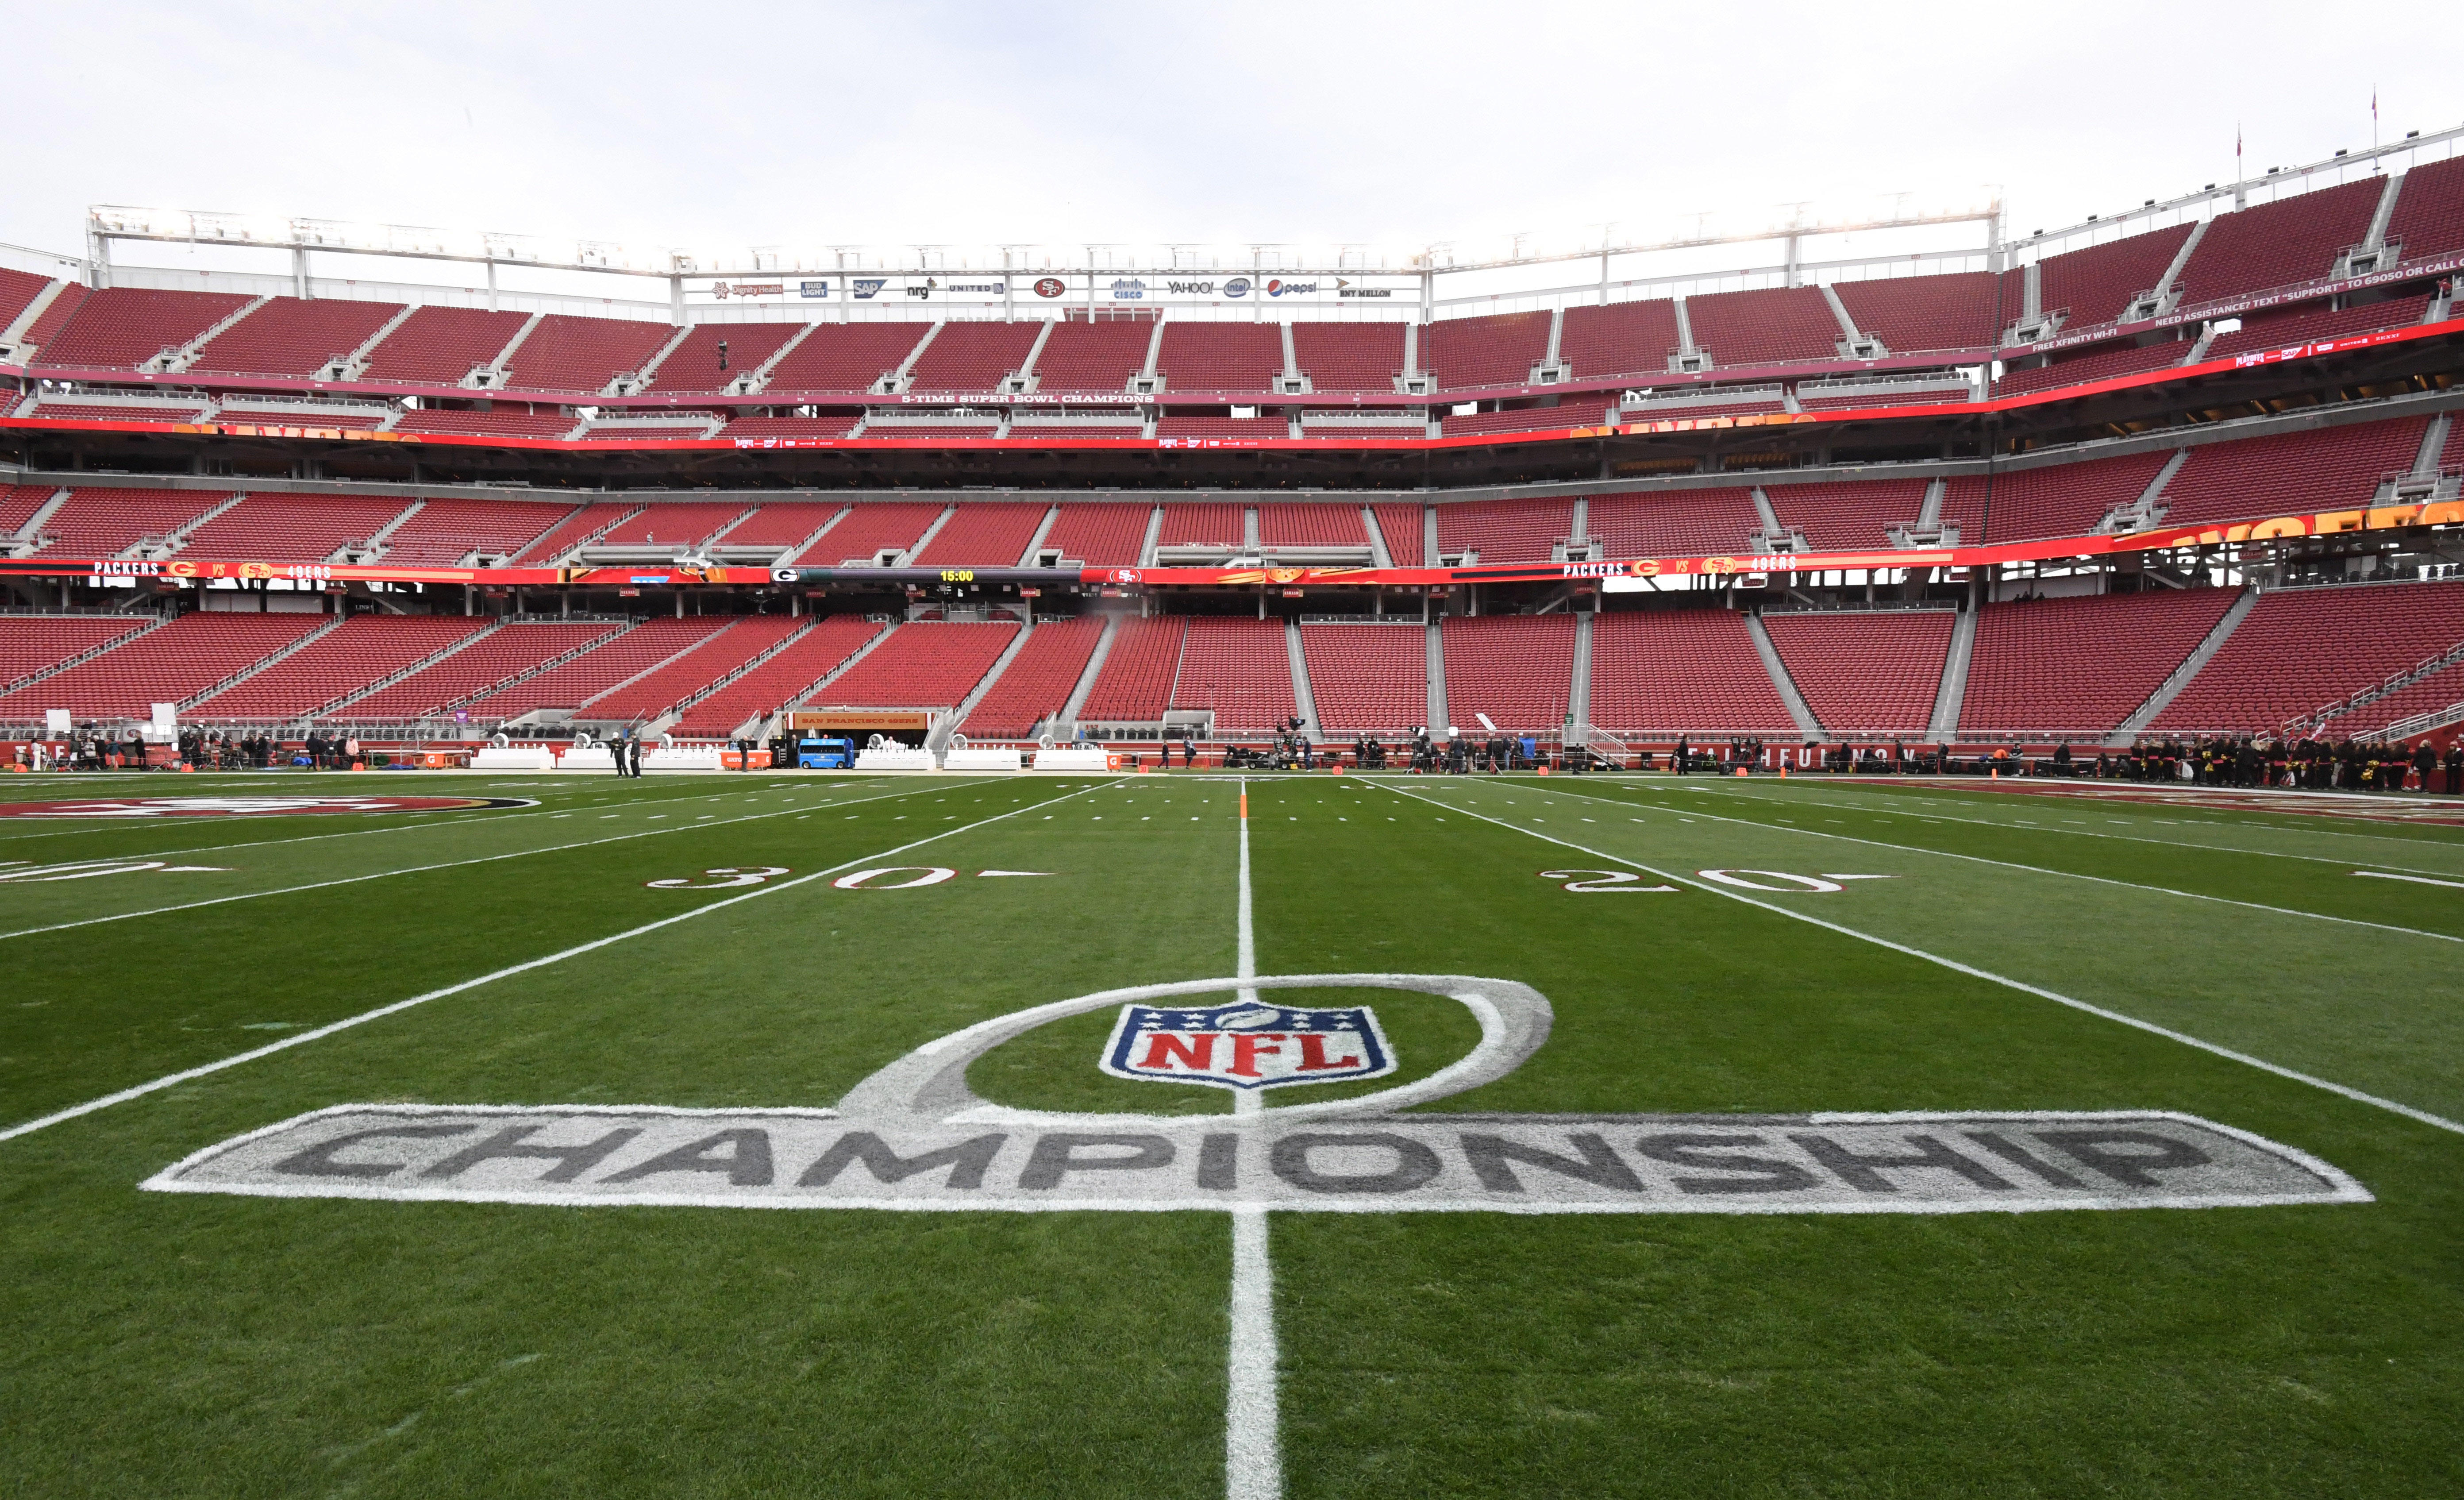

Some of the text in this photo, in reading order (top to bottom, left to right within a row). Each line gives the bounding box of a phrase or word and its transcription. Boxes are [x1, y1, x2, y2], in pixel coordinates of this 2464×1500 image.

[733, 286, 757, 296] Dignity
[854, 283, 878, 294] SAP
[908, 287, 928, 299] nrg
[1167, 281, 1214, 294] YAHOO!
[1285, 282, 1316, 294] pepsi
[2156, 316, 2182, 327] NEED
[2183, 301, 2250, 321] ASSISTANCE?
[2253, 295, 2280, 307] TEXT
[2346, 279, 2362, 288] TO
[2364, 271, 2403, 285] 69050
[2406, 267, 2423, 277] OR
[2426, 260, 2456, 273] CALL
[2033, 328, 2117, 352] FREE XFINITY WI-FI
[2236, 353, 2264, 367] PLAYOFFS
[94, 562, 158, 575] PACKERS
[213, 564, 225, 576] VS
[287, 565, 331, 578] 49ERS
[1563, 563, 1623, 577] PACKERS
[1676, 560, 1689, 573] VS
[1751, 556, 1796, 570] 49ERS
[940, 570, 973, 581] 15:00
[428, 755, 435, 763] G
[1110, 757, 1117, 766] G
[1136, 1034, 1360, 1078] NFL
[272, 1124, 2212, 1194] CHAMPIONSHIP
